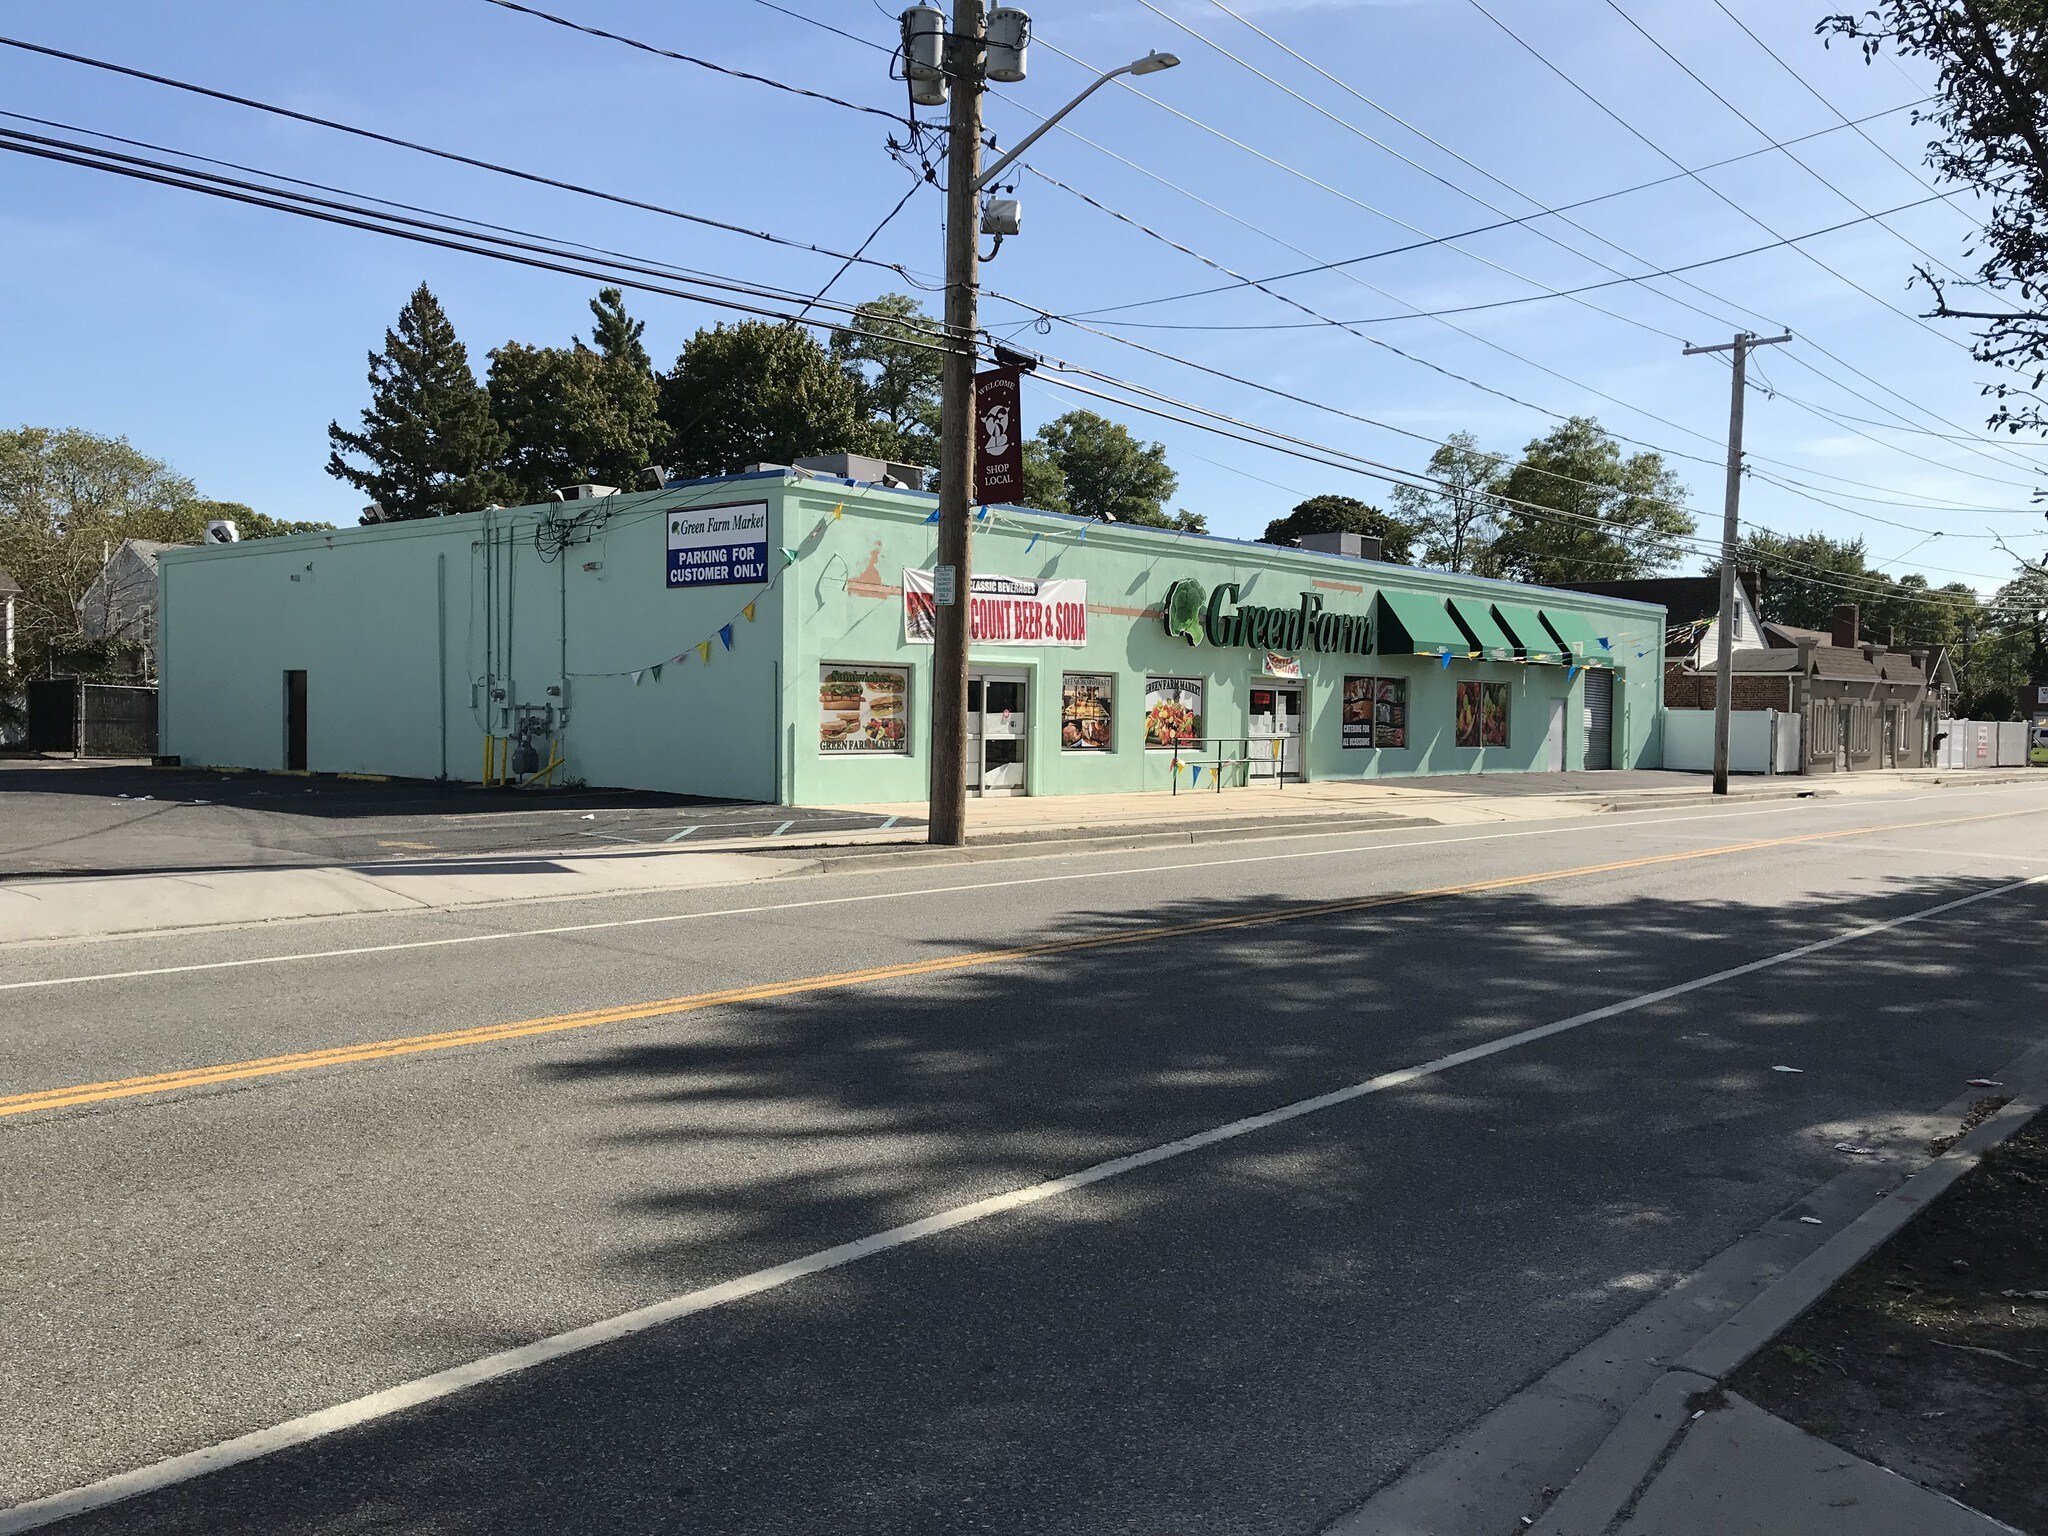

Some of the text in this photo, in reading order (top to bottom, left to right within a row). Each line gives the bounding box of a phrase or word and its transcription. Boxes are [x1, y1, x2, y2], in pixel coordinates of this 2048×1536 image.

[978, 380, 1016, 395] WELCOME
[986, 463, 1010, 475] SHOP
[985, 475, 1013, 486] LOCAL
[680, 513, 765, 535] Green Farm Market
[679, 546, 755, 566] PARKING FOR
[670, 563, 765, 583] CUSTOMER ONLY
[997, 581, 1036, 595] BEVERAGES
[970, 598, 1086, 641] COUNT BEER & SODA
[831, 670, 890, 682] Sandwiches
[1163, 679, 1179, 690] FARM
[1180, 680, 1201, 696] MARKET
[819, 740, 848, 750] GREEN
